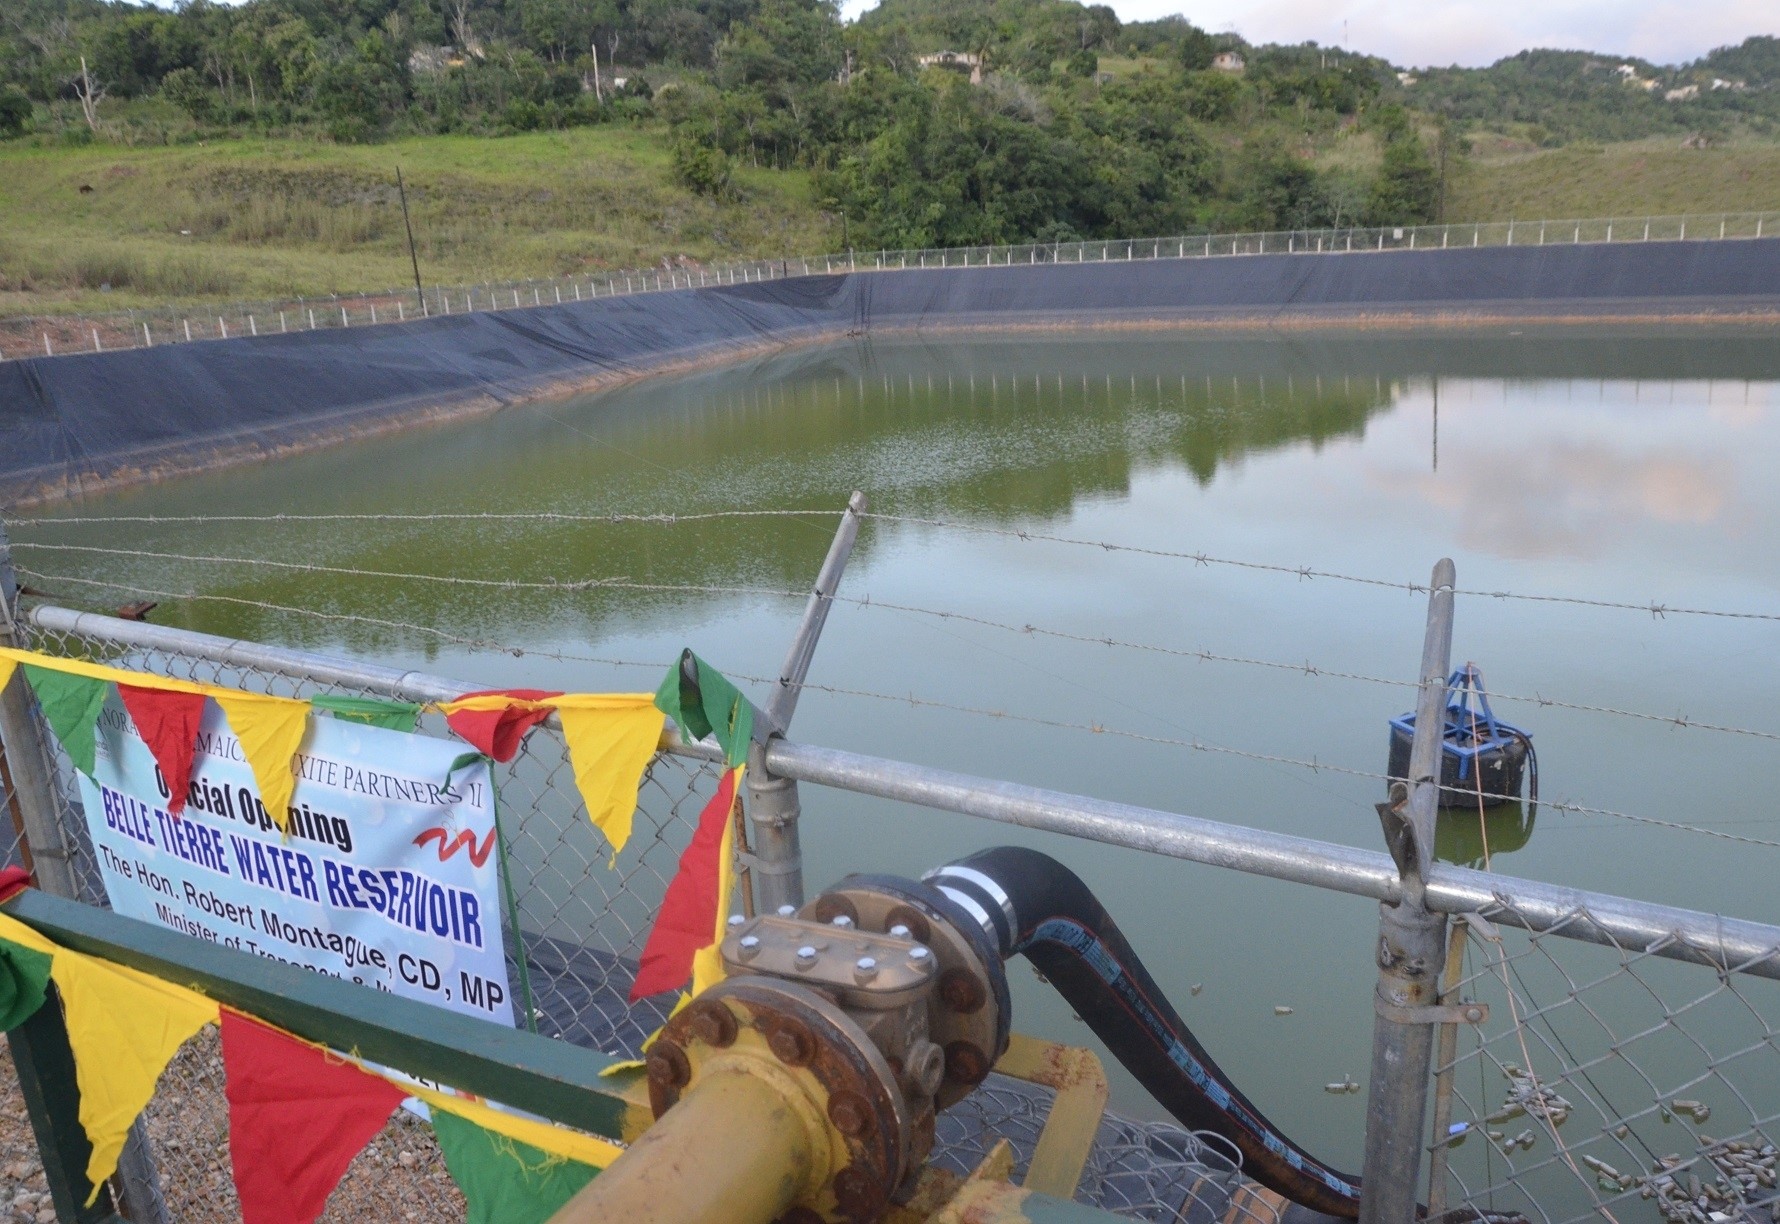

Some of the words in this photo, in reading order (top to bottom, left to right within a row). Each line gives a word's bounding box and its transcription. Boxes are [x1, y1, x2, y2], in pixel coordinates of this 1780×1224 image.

[155, 763, 236, 820] Ocial
[194, 730, 248, 763] MAIC
[290, 752, 338, 787] XITE
[344, 765, 463, 805] PARTNERS
[470, 782, 483, 809] II
[102, 786, 156, 847] BELLE
[154, 808, 230, 875] TIERRE
[229, 834, 320, 903] WATER
[322, 859, 483, 949] RESERVOIR
[99, 843, 133, 879] The
[134, 860, 180, 900] Hon.
[182, 880, 257, 931] Robert
[260, 908, 393, 979] Montague,
[398, 953, 451, 1001] CD,
[460, 970, 504, 1012] MP
[155, 902, 218, 943] Minister
